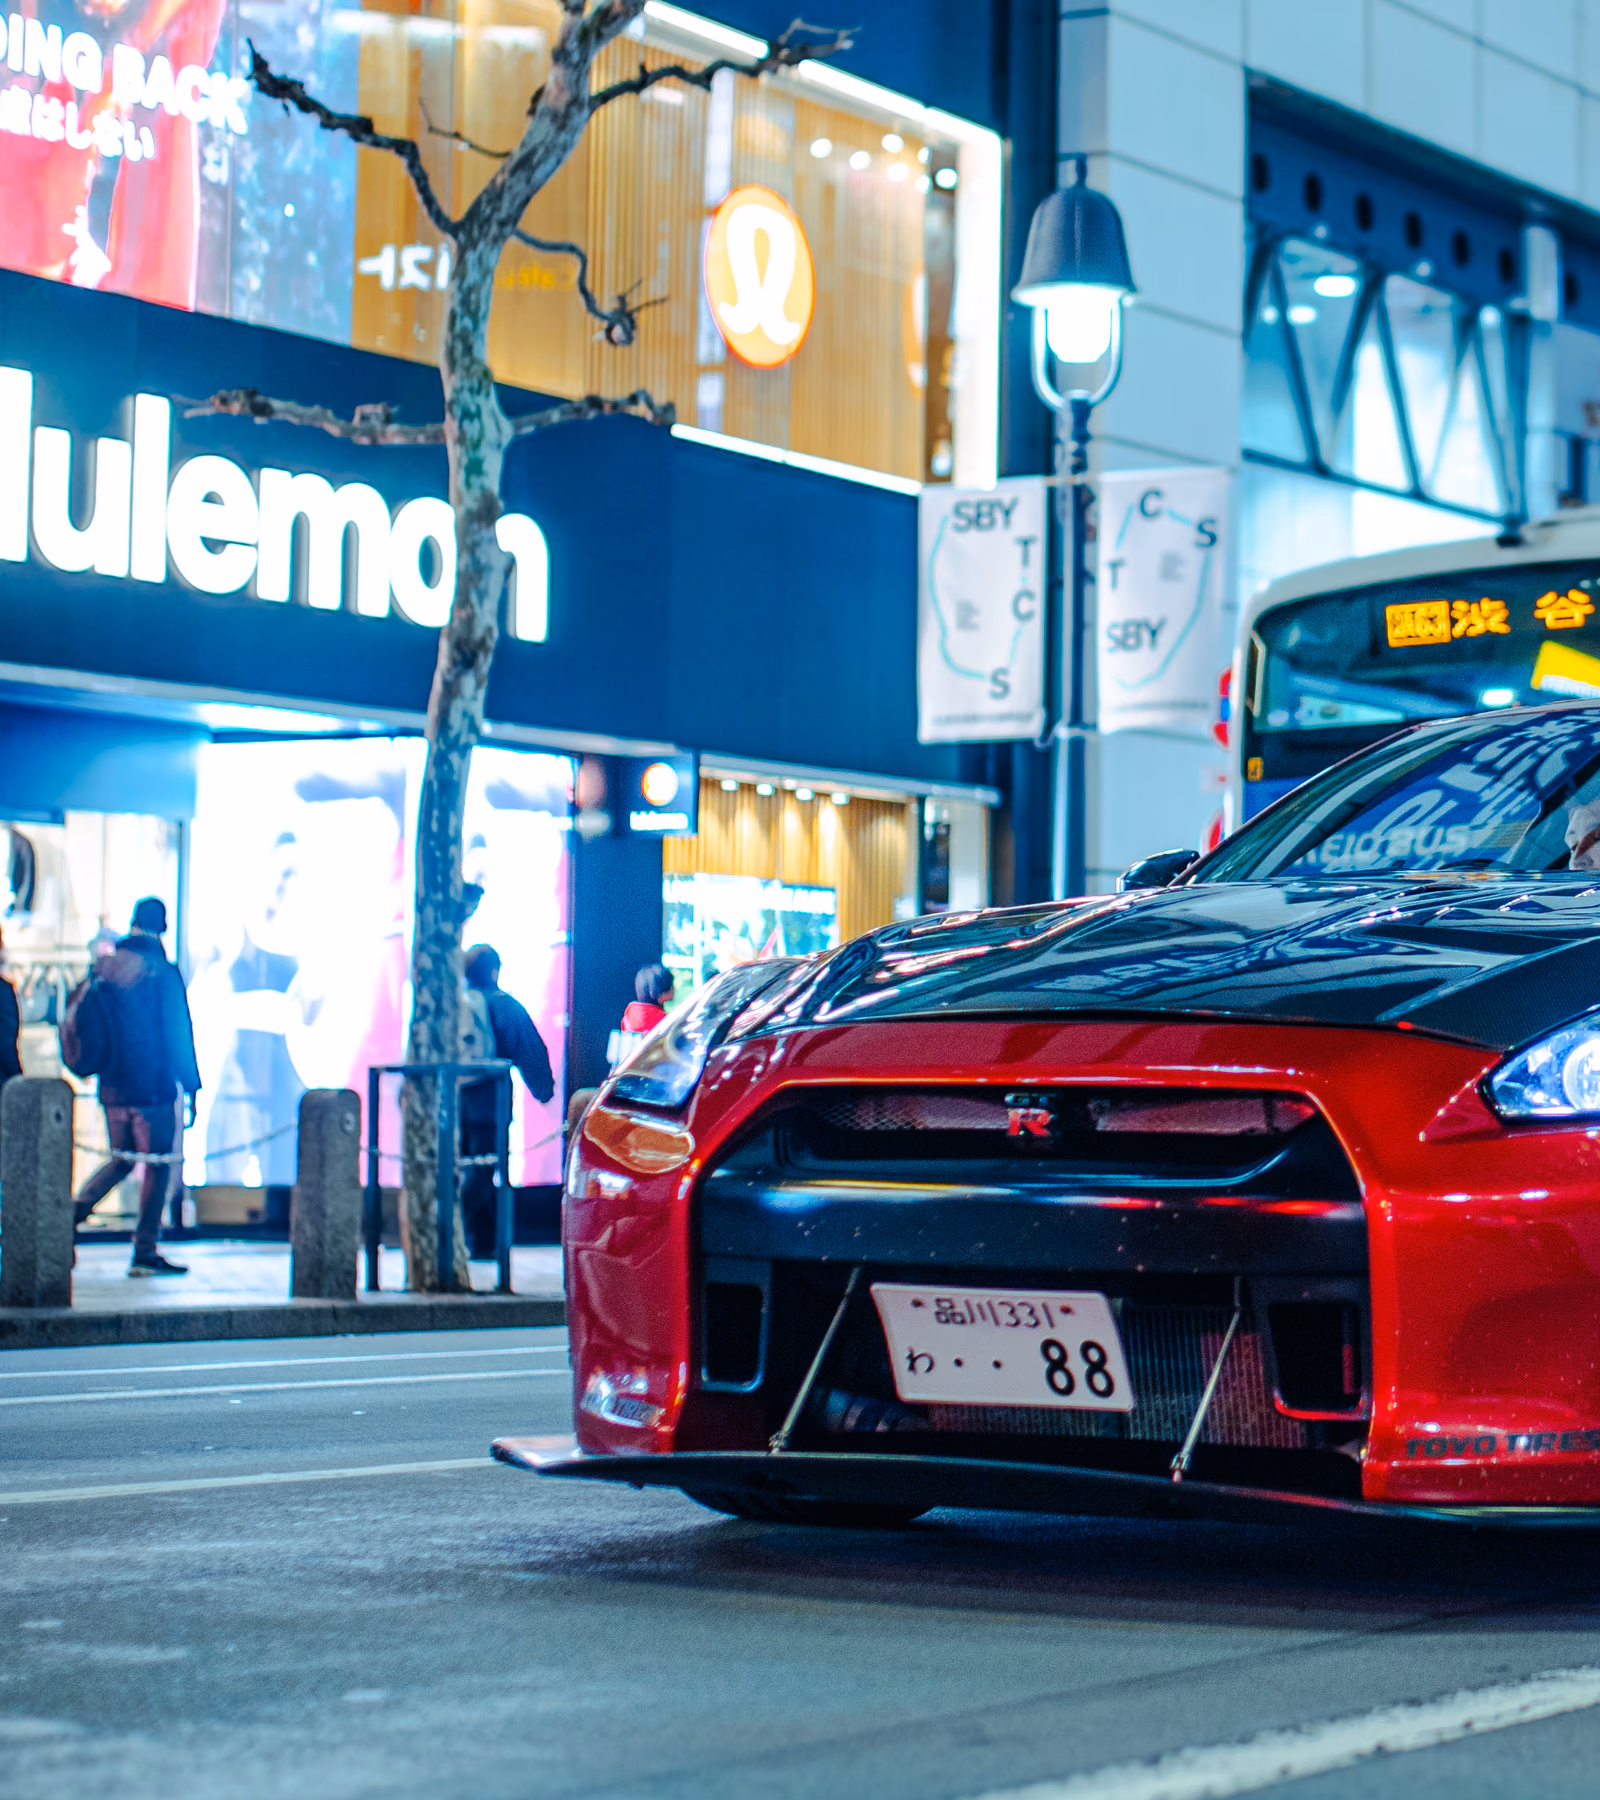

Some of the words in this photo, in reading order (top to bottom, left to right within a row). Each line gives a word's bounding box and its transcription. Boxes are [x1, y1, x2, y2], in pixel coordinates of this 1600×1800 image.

[0, 12, 103, 95] ING
[111, 42, 249, 136] BACK
[951, 496, 1019, 533] SBY
[1139, 490, 1163, 519] C
[1194, 519, 1218, 549] S
[1014, 535, 1038, 569] T
[1105, 557, 1127, 592] T
[1012, 589, 1036, 622] C
[1105, 617, 1167, 653] SBY
[989, 667, 1011, 700] S
[905, 1346, 935, 1376] わ
[1040, 1338, 1115, 1398] 88
[1406, 1434, 1497, 1459] TOYO
